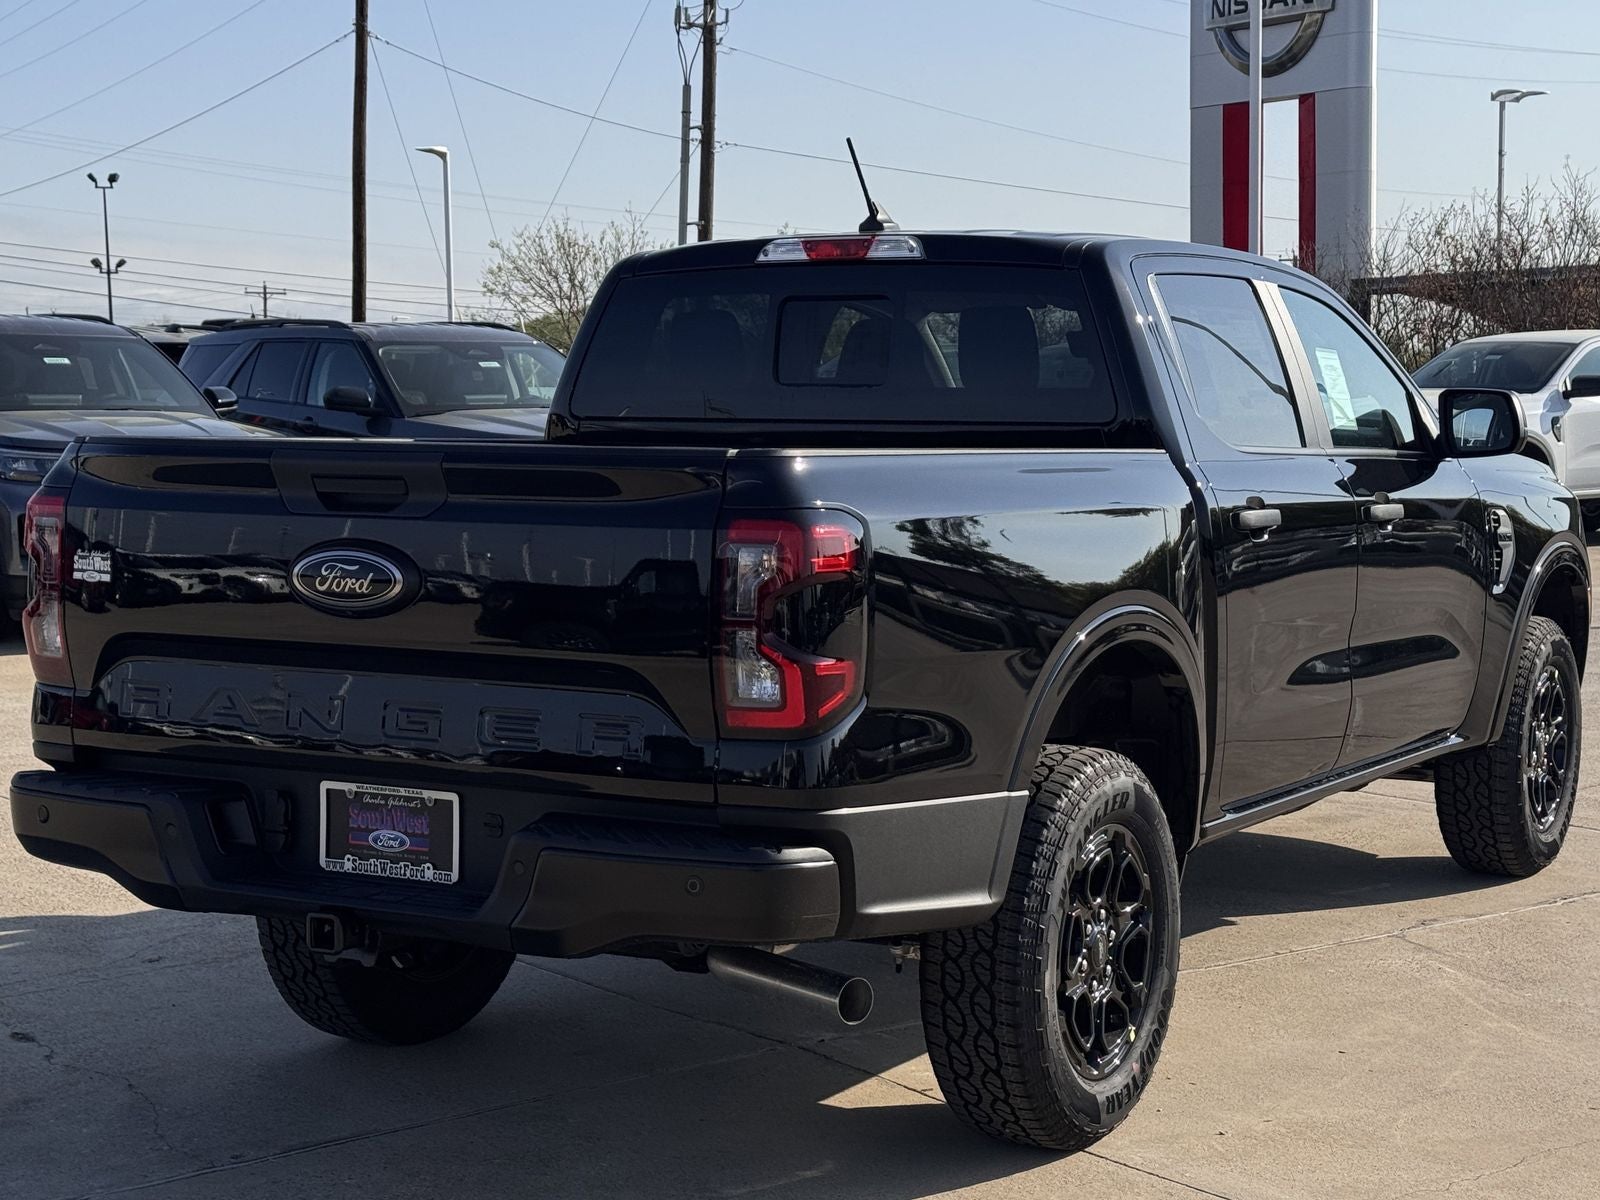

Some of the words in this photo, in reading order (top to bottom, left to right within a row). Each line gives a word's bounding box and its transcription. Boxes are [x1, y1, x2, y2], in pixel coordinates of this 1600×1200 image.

[1211, 0, 1315, 20] NIS
[73, 555, 111, 571] SouthWest
[315, 562, 374, 594] Ford
[119, 679, 647, 760] RANGER
[349, 804, 430, 835] SouthWest
[377, 833, 401, 848] Ford
